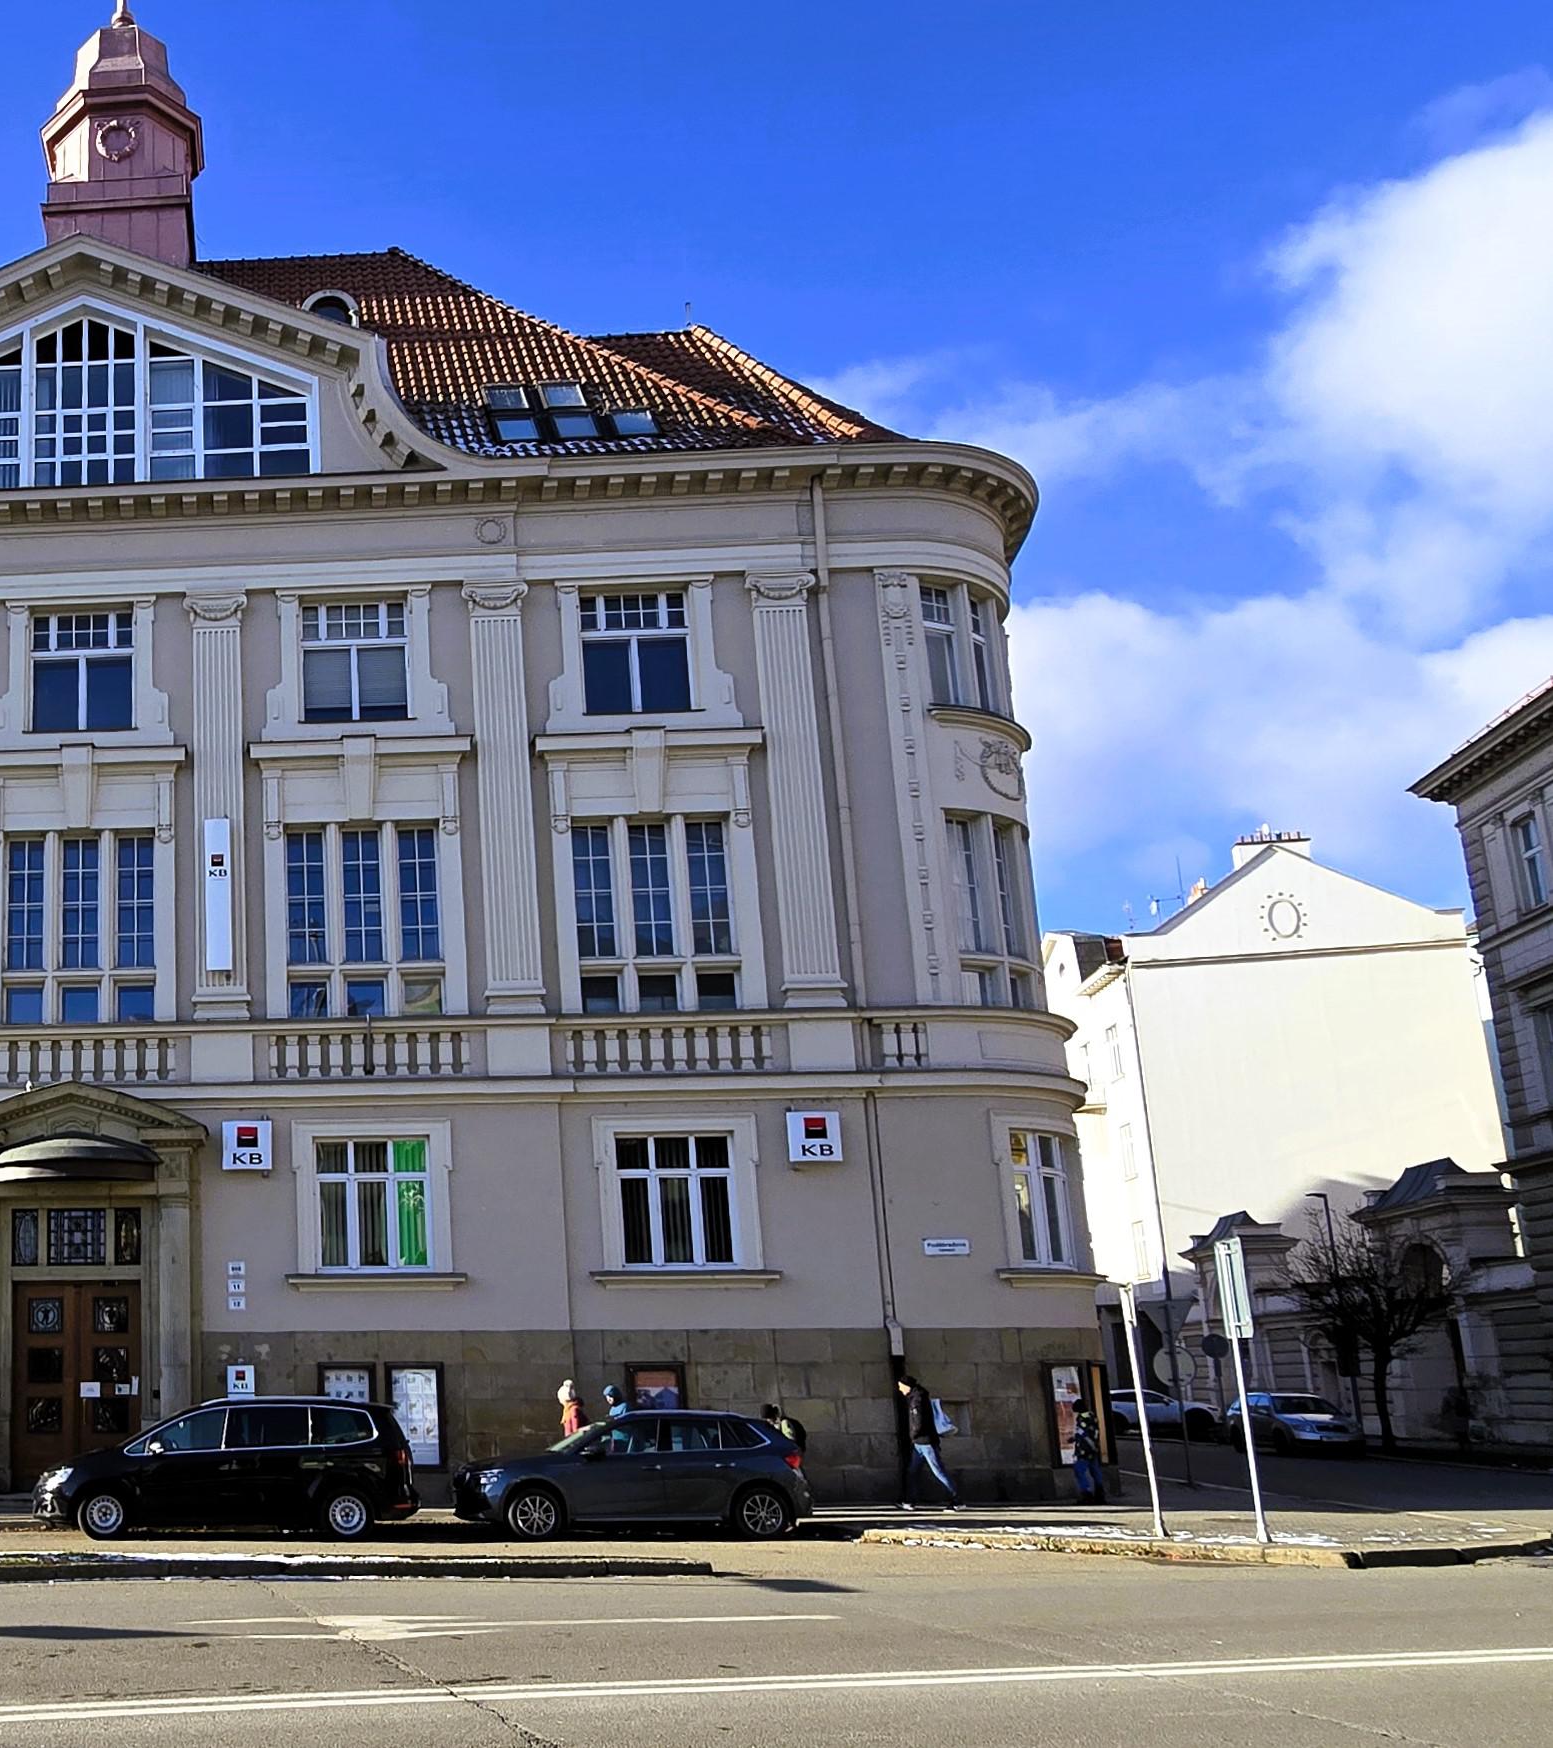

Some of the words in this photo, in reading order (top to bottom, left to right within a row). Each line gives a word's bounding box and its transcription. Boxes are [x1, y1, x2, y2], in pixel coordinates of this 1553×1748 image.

[209, 868, 227, 876] KB
[801, 1144, 834, 1156] KB
[232, 1152, 263, 1164] KB
